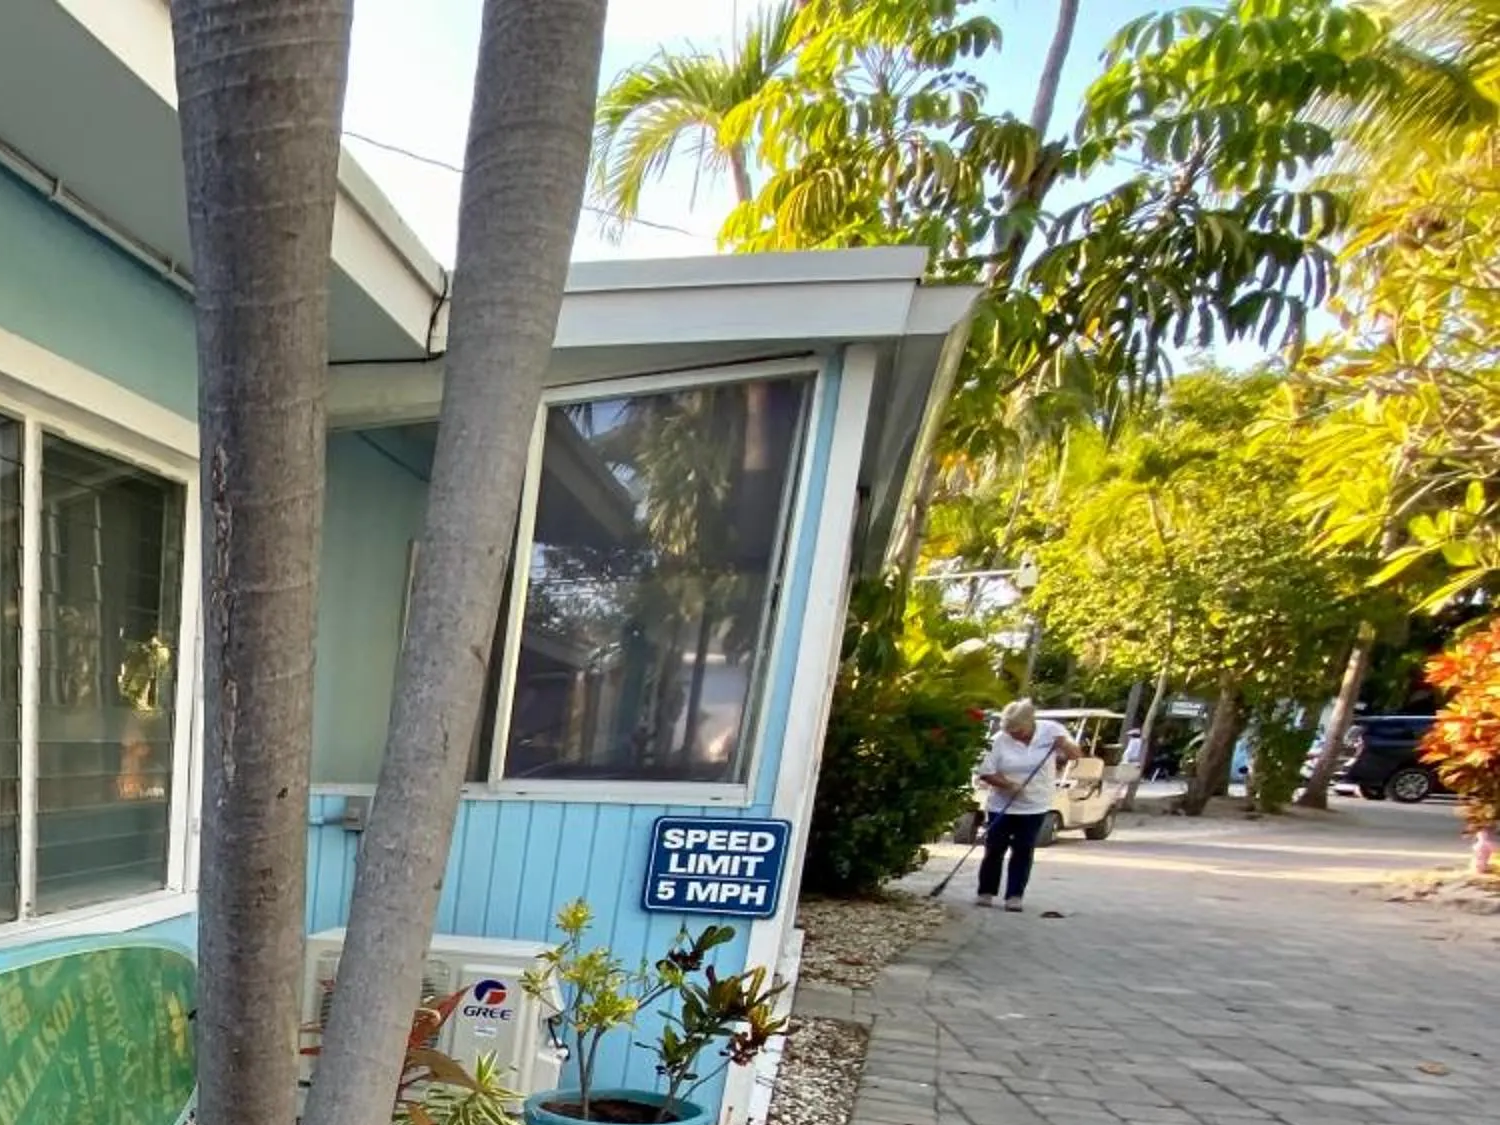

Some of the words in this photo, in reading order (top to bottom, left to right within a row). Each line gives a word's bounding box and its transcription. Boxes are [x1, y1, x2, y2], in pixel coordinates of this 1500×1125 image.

[663, 828, 776, 853] SPEED
[668, 853, 765, 877] LIMIT
[656, 880, 676, 900] 5
[686, 881, 767, 906] MPH
[463, 1005, 513, 1020] GREE
